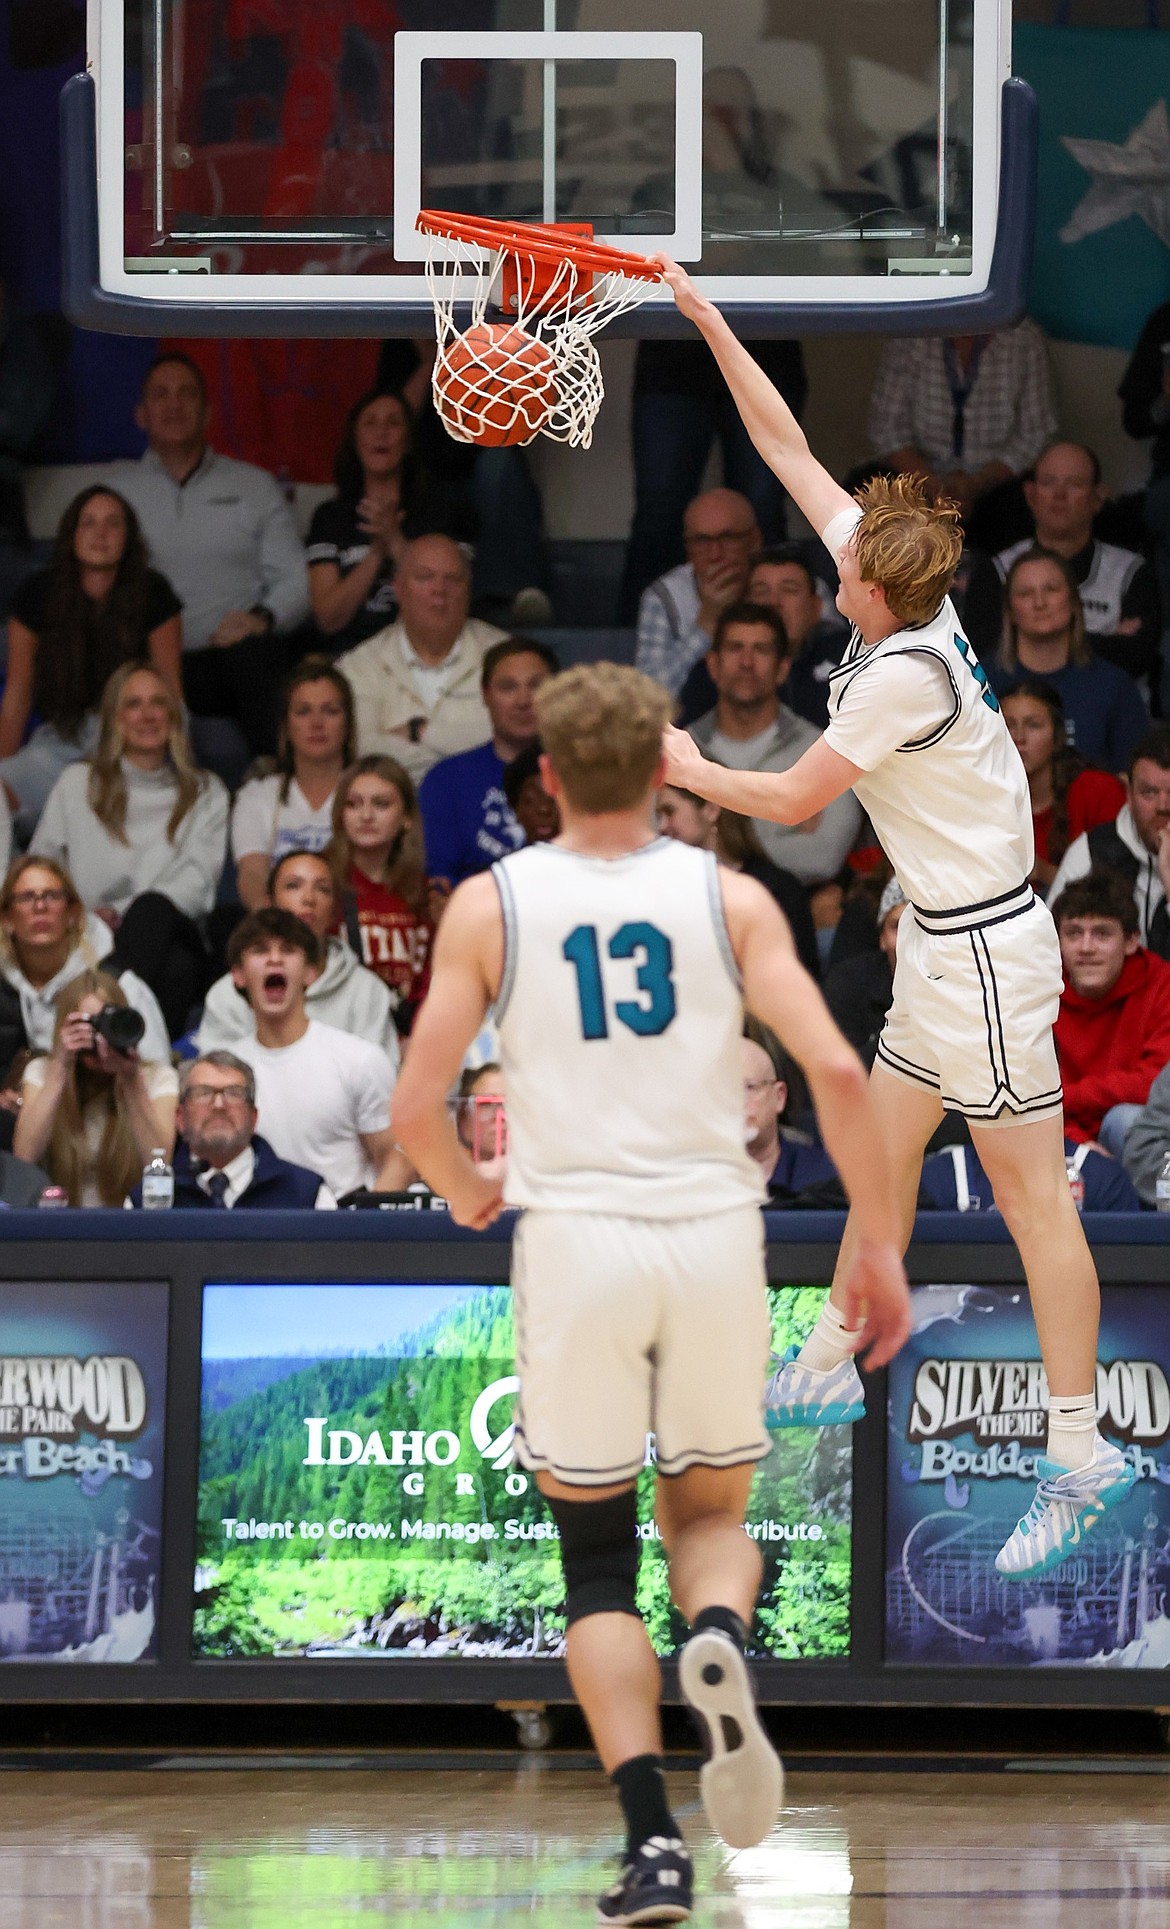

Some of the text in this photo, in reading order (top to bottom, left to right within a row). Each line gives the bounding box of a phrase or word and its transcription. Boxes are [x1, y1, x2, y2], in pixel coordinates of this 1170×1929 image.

[953, 631, 999, 714] 5
[562, 921, 677, 1040] 13
[0, 1356, 146, 1432] RWOOD
[910, 1359, 1170, 1436] SILVEROOD
[21, 1406, 76, 1433] PARK
[303, 1418, 461, 1466] IDAHO
[977, 1411, 1045, 1436] THEME
[24, 1437, 132, 1477] Beach
[221, 1518, 294, 1540] Talent
[299, 1520, 325, 1540] to
[328, 1518, 396, 1540] Grow.
[401, 1518, 500, 1544] Manage.
[740, 1519, 827, 1541] tribute.
